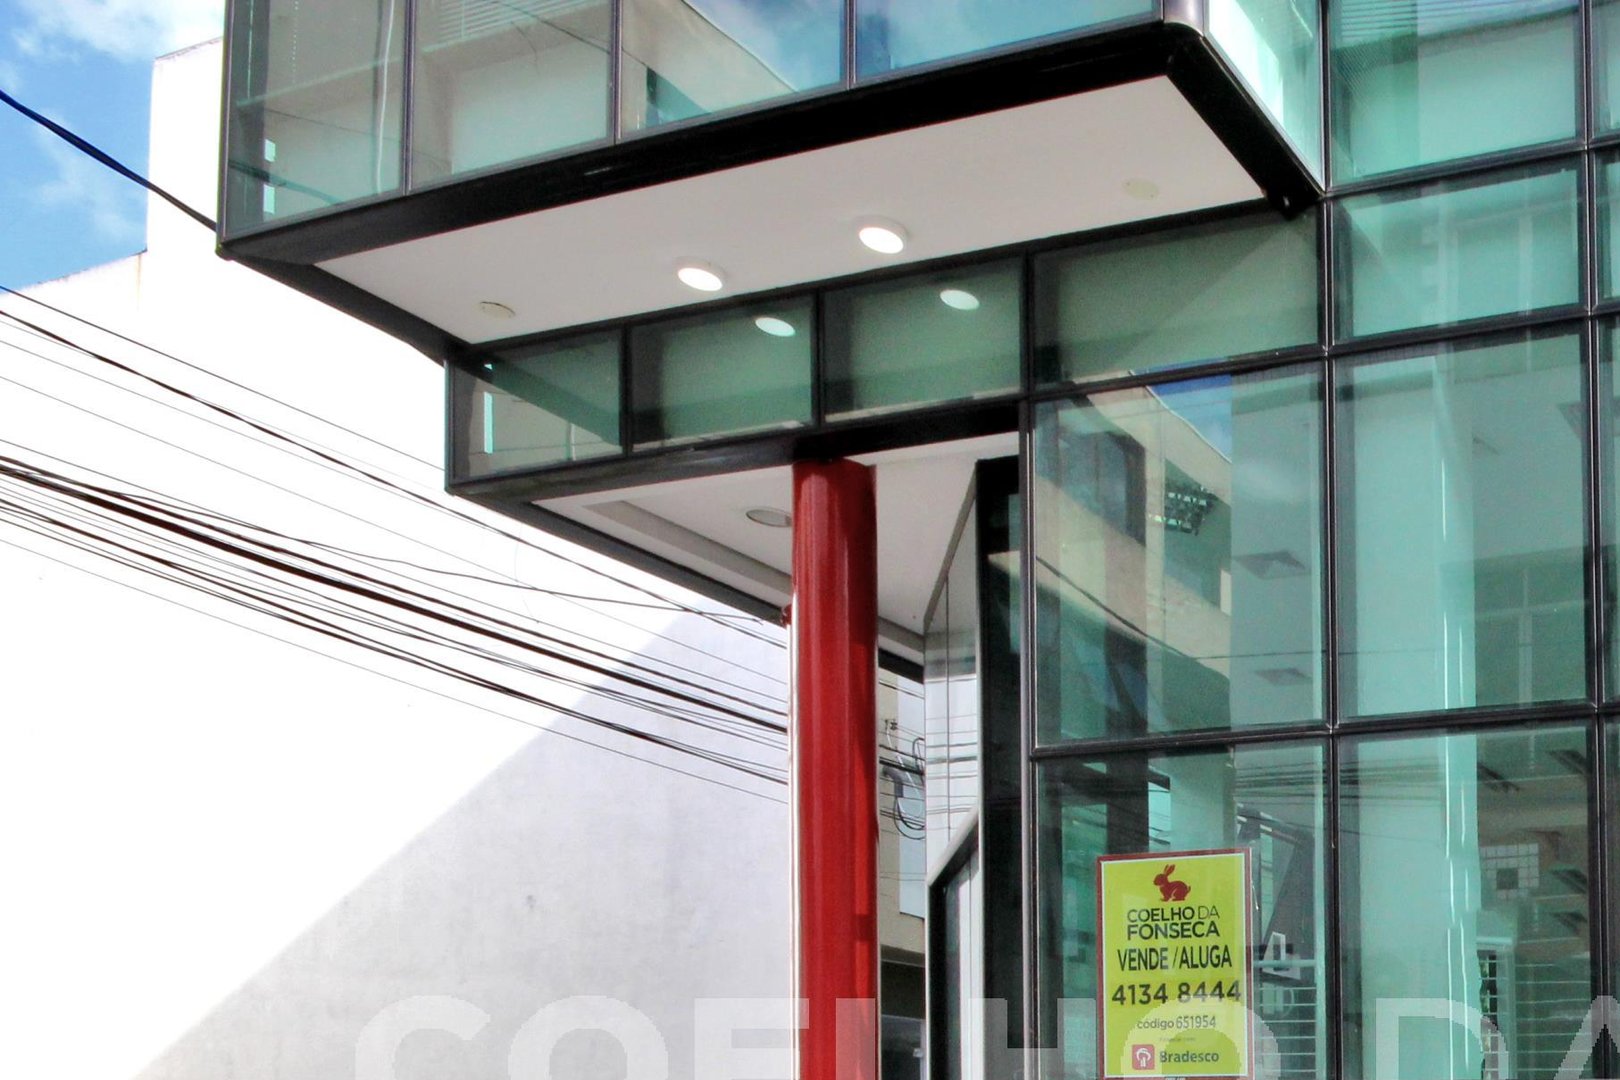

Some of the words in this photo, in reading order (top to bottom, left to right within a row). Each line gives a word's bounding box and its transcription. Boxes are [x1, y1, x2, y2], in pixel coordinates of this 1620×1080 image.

[1127, 906, 1195, 923] COELHO
[1197, 905, 1220, 920] DA
[1127, 921, 1220, 941] FONSECA
[1117, 947, 1169, 971] VENDE
[1112, 982, 1168, 1006] 4134
[1177, 979, 1241, 1005] 8444
[1176, 1014, 1216, 1030] 651954
[1159, 1050, 1220, 1063] Bradesco
